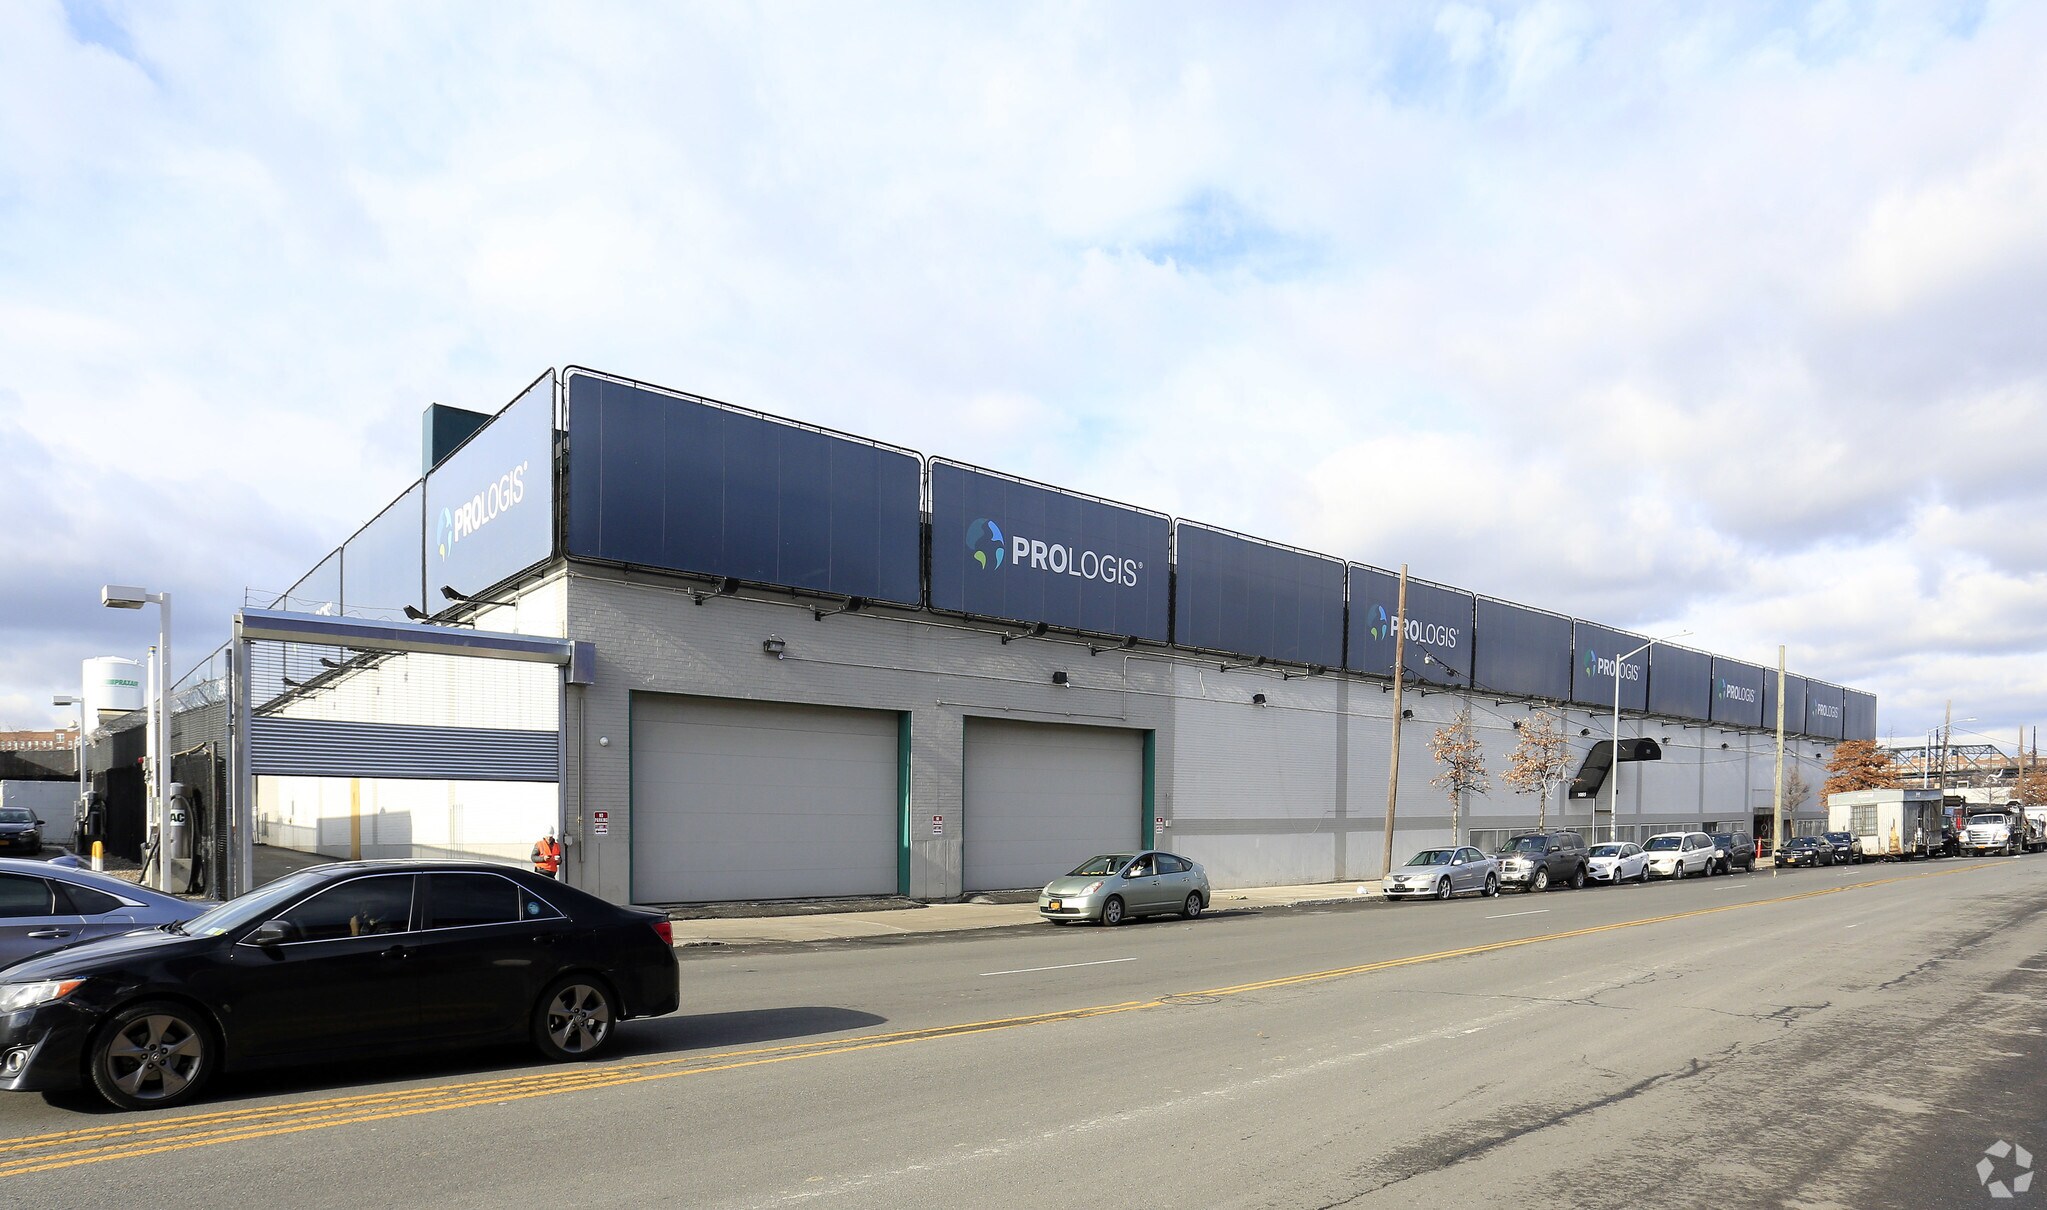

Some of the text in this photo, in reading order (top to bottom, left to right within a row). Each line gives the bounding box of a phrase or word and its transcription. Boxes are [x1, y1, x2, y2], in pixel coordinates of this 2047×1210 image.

[454, 465, 525, 543] PROLOGIS
[1012, 536, 1138, 587] PROLOGIS
[1597, 657, 1639, 681] PROOGIS
[1726, 684, 1755, 703] PROLOGIS
[170, 813, 185, 823] AC
